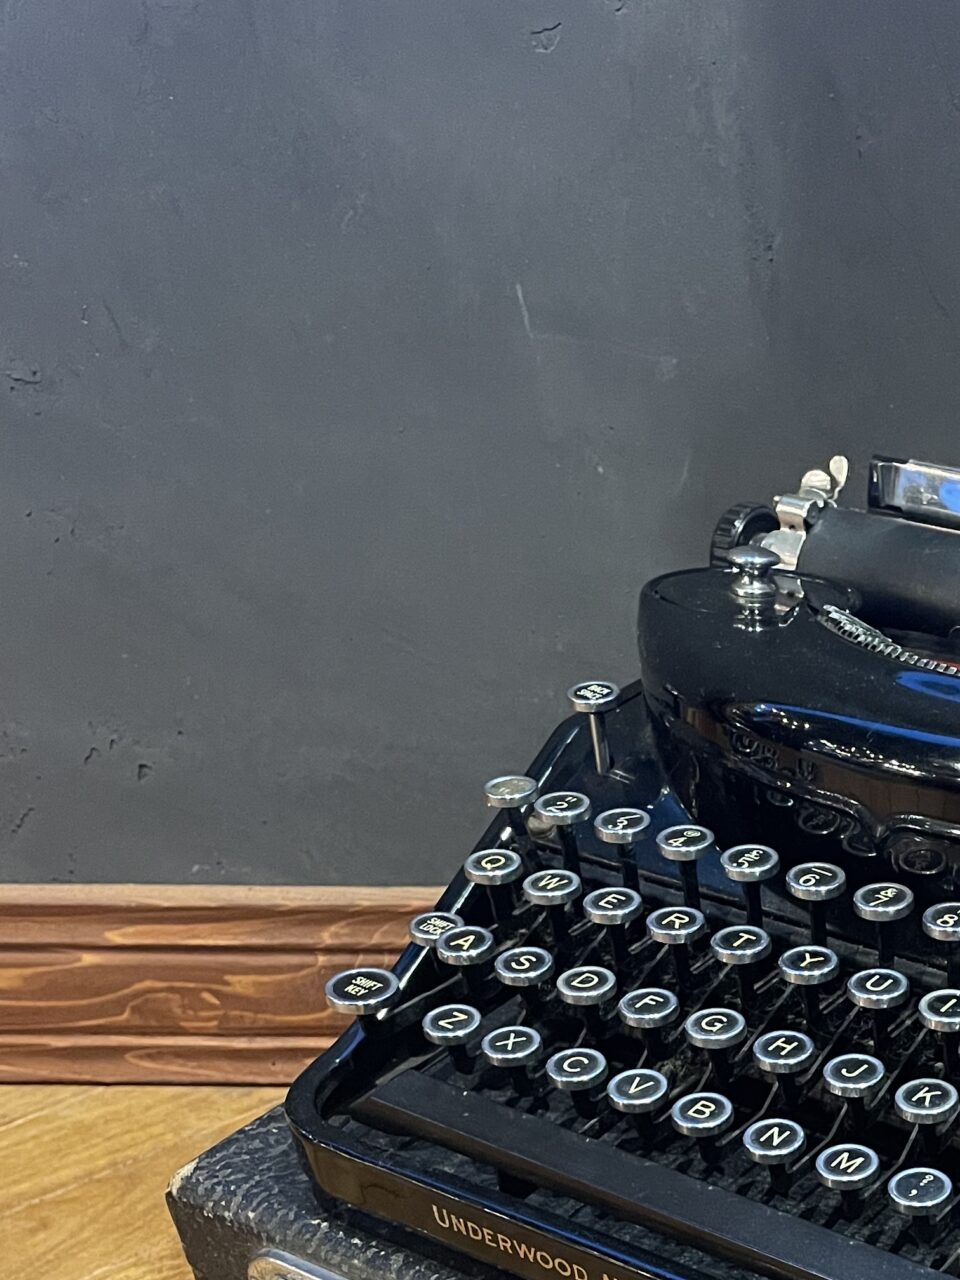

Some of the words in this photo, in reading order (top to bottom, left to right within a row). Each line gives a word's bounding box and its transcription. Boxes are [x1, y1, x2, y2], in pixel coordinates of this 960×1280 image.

[546, 801, 568, 813] 2
[667, 836, 687, 848] 4
[481, 856, 505, 870] Q
[538, 875, 568, 889] W
[798, 873, 820, 886] 6
[599, 894, 626, 908] E
[426, 917, 456, 931] SHIFT
[662, 913, 689, 928] R
[936, 913, 958, 927] 8
[419, 923, 445, 936] LOCK
[450, 935, 475, 950] A
[733, 933, 756, 946] T
[510, 955, 537, 970] S
[800, 953, 824, 967] Y
[352, 976, 384, 990] SHIFT
[571, 973, 598, 987] D
[866, 975, 893, 991] U
[344, 985, 369, 997] KEY
[635, 995, 664, 1008] F
[438, 1012, 468, 1029] Z
[701, 1016, 727, 1032] G
[496, 1033, 526, 1050] X
[768, 1038, 798, 1055] H
[563, 1057, 589, 1072] C
[841, 1065, 868, 1077] J
[628, 1077, 654, 1094] V
[912, 1087, 941, 1107] K
[687, 1101, 715, 1118] B
[760, 1127, 790, 1146] N
[830, 1152, 865, 1173] M
